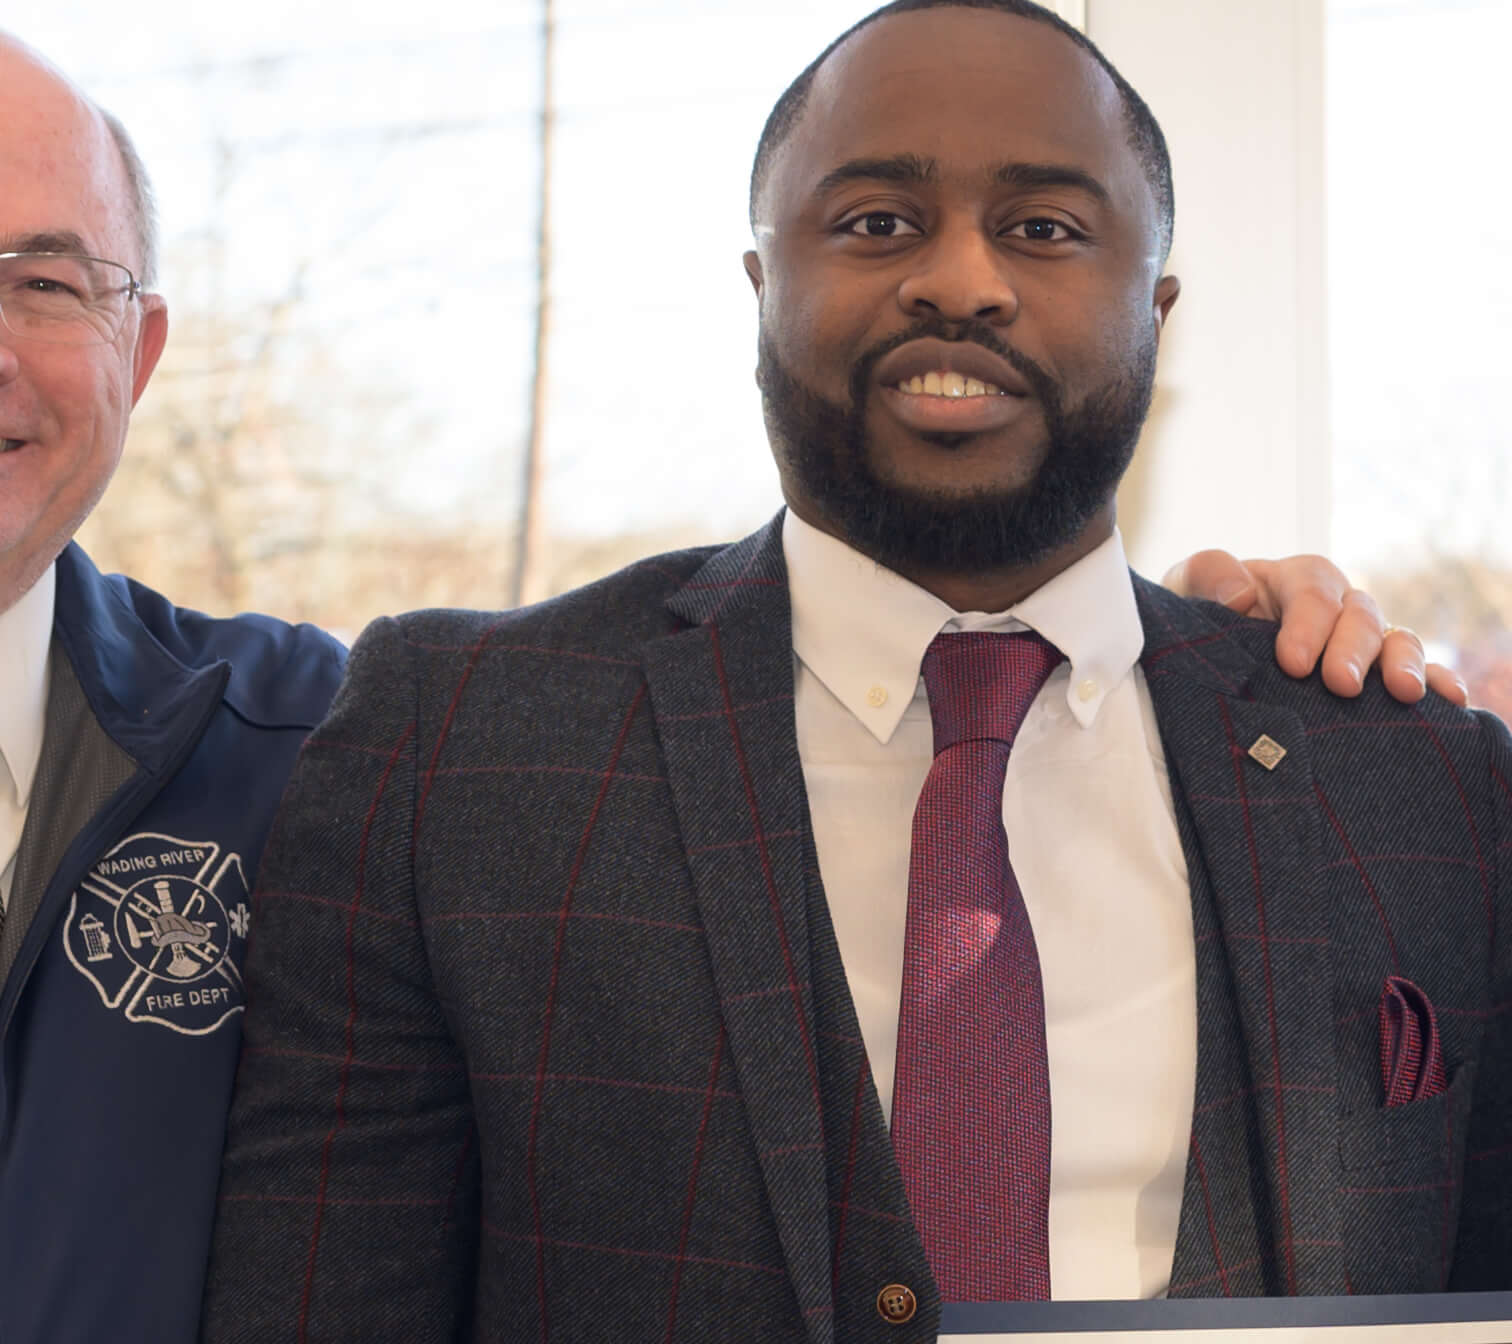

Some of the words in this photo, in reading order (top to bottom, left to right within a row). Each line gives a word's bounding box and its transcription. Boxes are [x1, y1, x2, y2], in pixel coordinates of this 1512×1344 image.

[97, 855, 157, 875] WADING
[159, 849, 204, 867] RIVER
[146, 993, 184, 1012] FIRE
[188, 988, 229, 1006] DEPT
